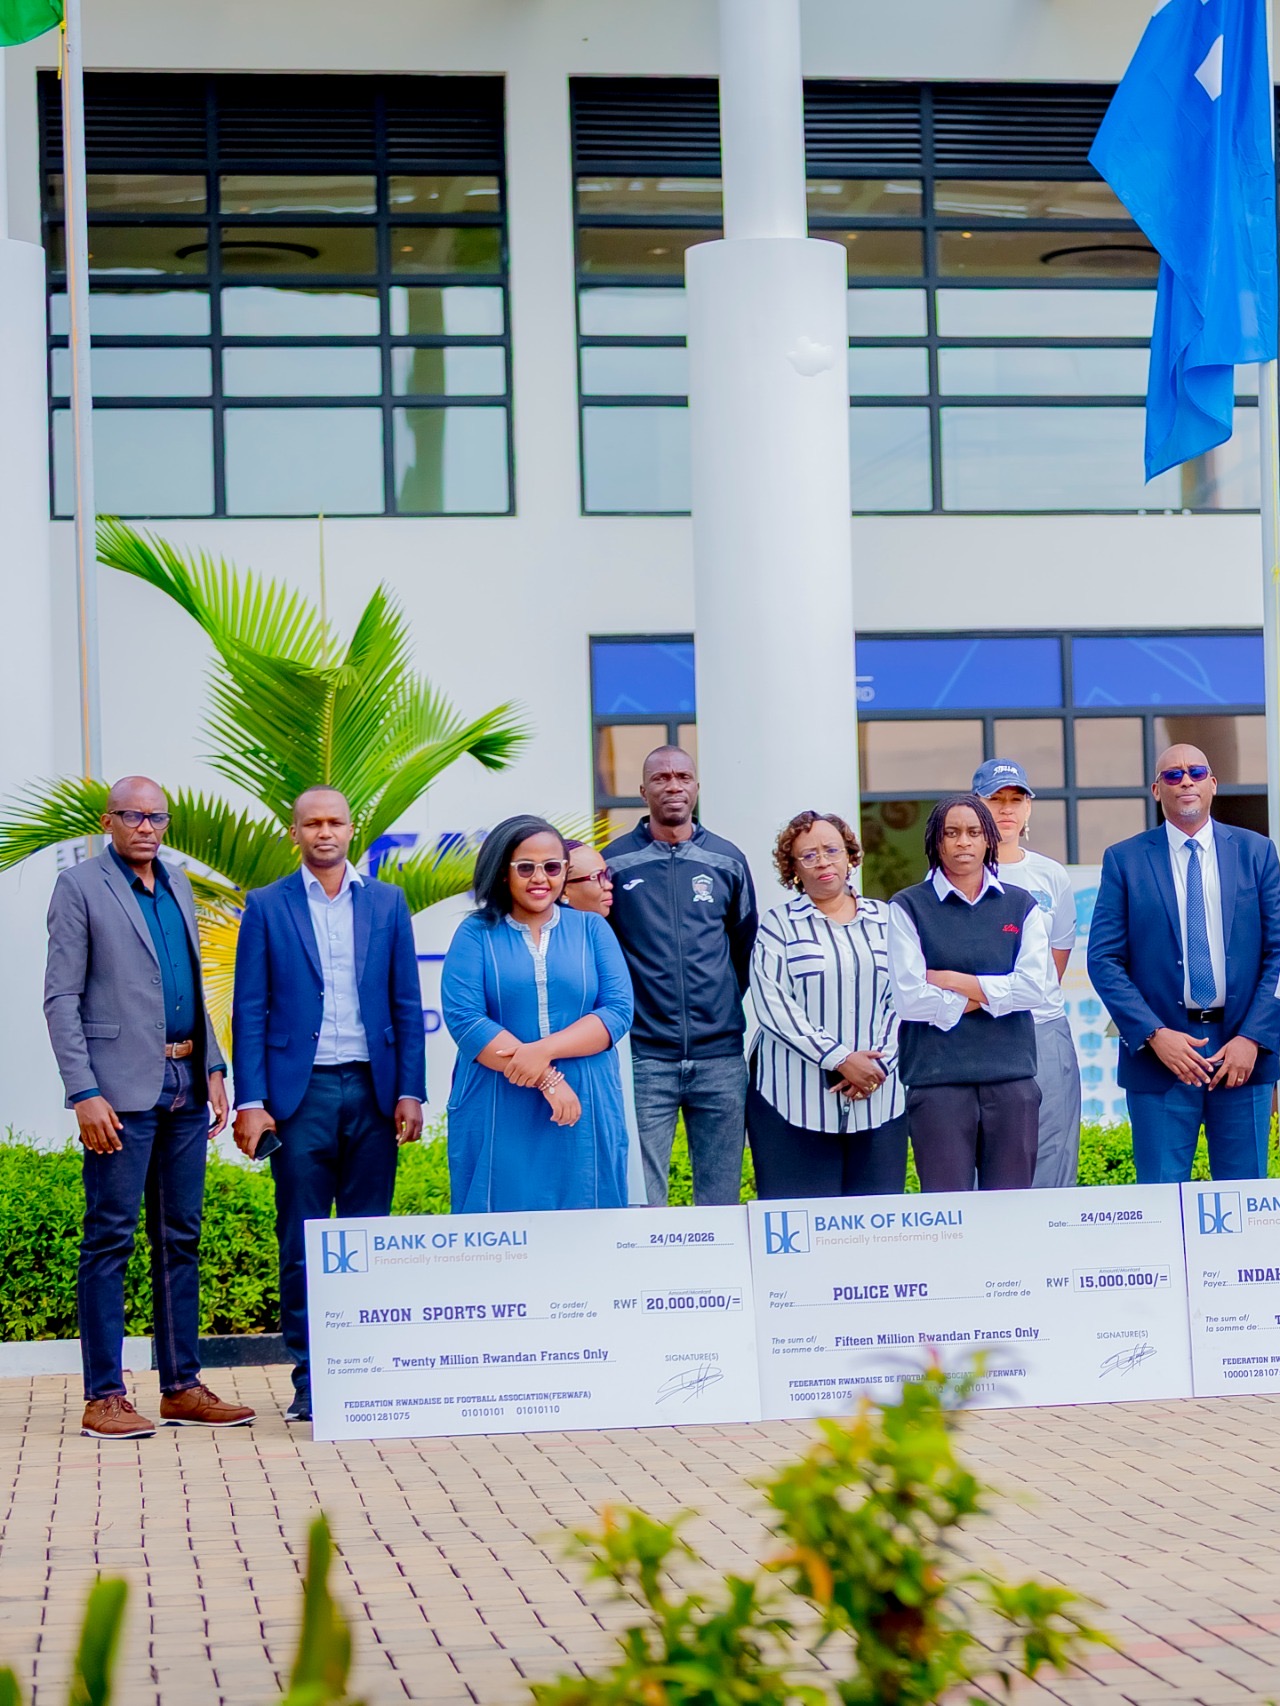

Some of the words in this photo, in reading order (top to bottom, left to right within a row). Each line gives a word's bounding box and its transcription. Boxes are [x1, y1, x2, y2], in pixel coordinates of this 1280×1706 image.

[815, 1215, 865, 1231] BANK
[871, 1214, 896, 1229] OF
[902, 1210, 962, 1227] KIGALI
[1081, 1211, 1143, 1223] 24/04/2026
[374, 1234, 426, 1250] BANK
[432, 1233, 458, 1248] OF
[465, 1231, 527, 1247] KIGALI
[650, 1232, 715, 1245] 24/04/2026
[816, 1236, 870, 1246] Financially
[873, 1233, 938, 1243] transforming
[941, 1232, 964, 1240] lives
[374, 1255, 430, 1265] Financially
[434, 1252, 502, 1263] transforming
[506, 1252, 528, 1260] lives
[1046, 1278, 1070, 1287] RWF
[1080, 1273, 1167, 1288] 15,000,000/=
[1203, 1270, 1220, 1278] Pay/
[769, 1291, 787, 1299] Pay/
[833, 1285, 889, 1301] POLICE
[894, 1283, 928, 1298] WFC
[563, 1301, 587, 1309] order/
[614, 1299, 637, 1309] RWF
[647, 1295, 740, 1310] 20,000,000/=
[325, 1311, 344, 1319] Pay/
[359, 1308, 412, 1324] RAYON
[423, 1305, 486, 1321] SPORTS
[492, 1304, 527, 1318] WFC
[835, 1335, 873, 1347] Fifteen
[877, 1333, 914, 1344] Million
[918, 1332, 970, 1342] Rwandan
[974, 1329, 1011, 1339] Francs
[1015, 1327, 1039, 1339] Only
[1097, 1330, 1149, 1339] SIGNATURE(S)
[393, 1357, 436, 1368] Twenty
[440, 1355, 479, 1365] Million
[483, 1353, 536, 1364] Rwandan
[541, 1351, 580, 1362] Francs
[583, 1349, 608, 1361] Only
[665, 1353, 719, 1362] SIGNATURE(S)
[1222, 1357, 1268, 1366] FEDERATION
[789, 1378, 836, 1387] FEDERATION
[838, 1376, 883, 1385] RWANDAISE
[344, 1400, 393, 1409] FEDERATION
[396, 1397, 441, 1406] RWANDAISE
[457, 1395, 497, 1403] FOOTBALL
[499, 1391, 592, 1402] ASSOCIATION(FERWAFA)
[790, 1390, 852, 1401] 100001281075
[345, 1412, 410, 1422] 100001281075
[462, 1408, 504, 1417] 01010101
[517, 1405, 560, 1414] 01010110
